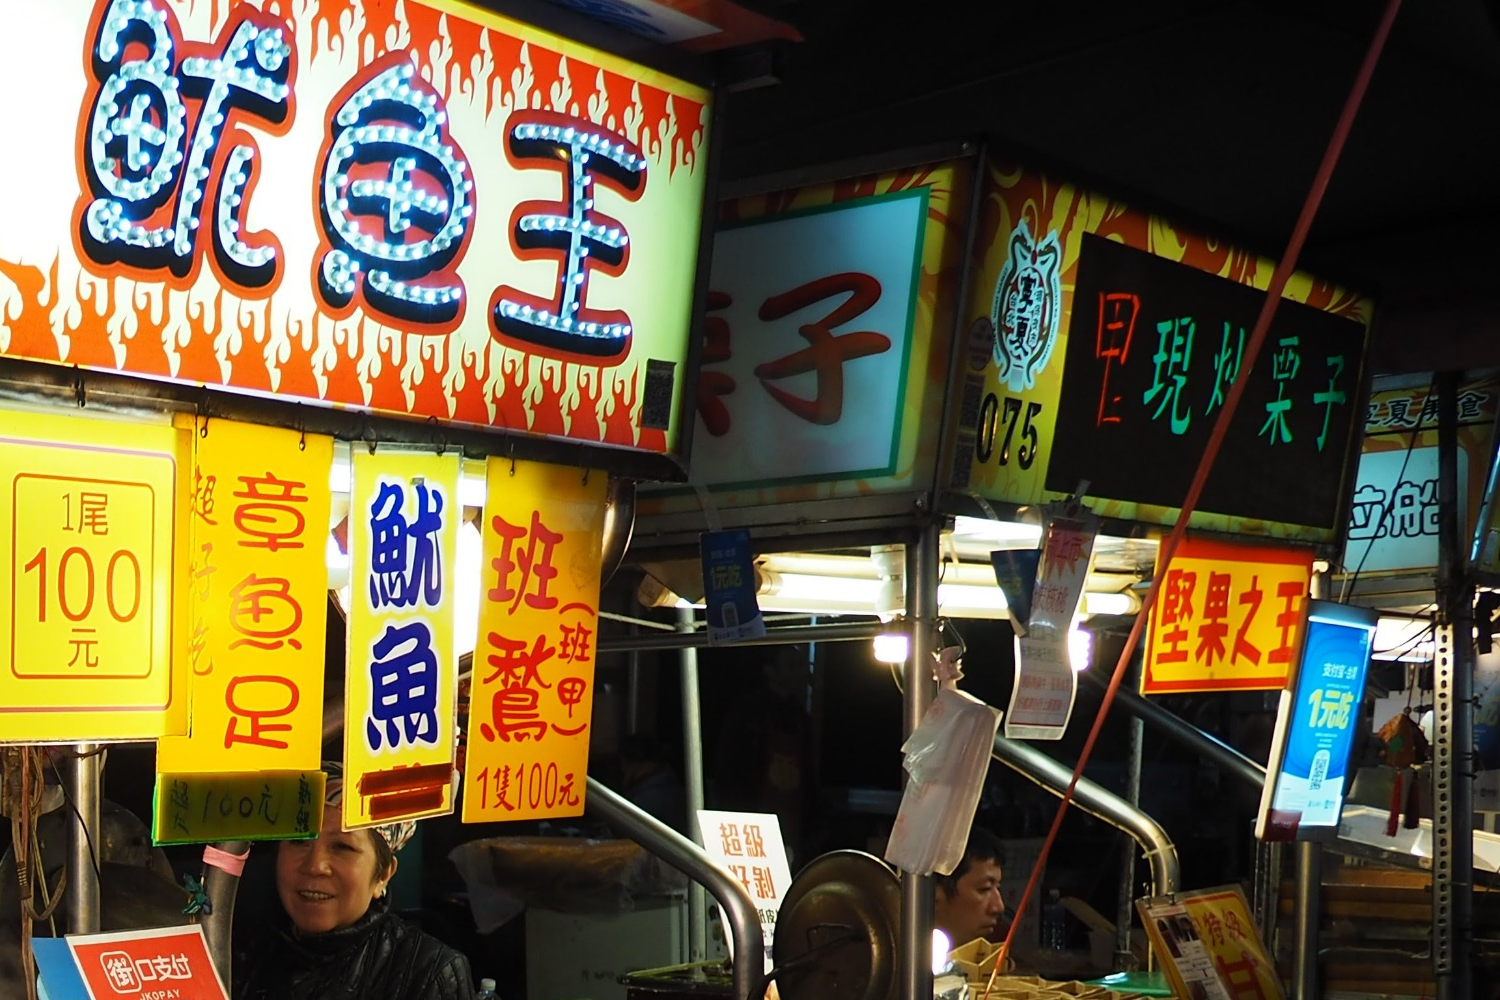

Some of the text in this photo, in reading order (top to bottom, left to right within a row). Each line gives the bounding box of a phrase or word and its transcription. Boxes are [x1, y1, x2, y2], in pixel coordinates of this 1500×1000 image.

[82, 0, 648, 355] 魷魚王
[977, 393, 1041, 471] 075
[61, 493, 109, 536] 1尾
[24, 547, 142, 624] 100
[224, 471, 309, 750] 章魚足
[364, 482, 444, 750] 魷魚
[1154, 569, 1305, 667] 堅果之王
[68, 629, 99, 669] 元
[477, 762, 579, 812] 1隻100元
[719, 823, 767, 858] 超級
[100, 950, 193, 994] 街口支付
